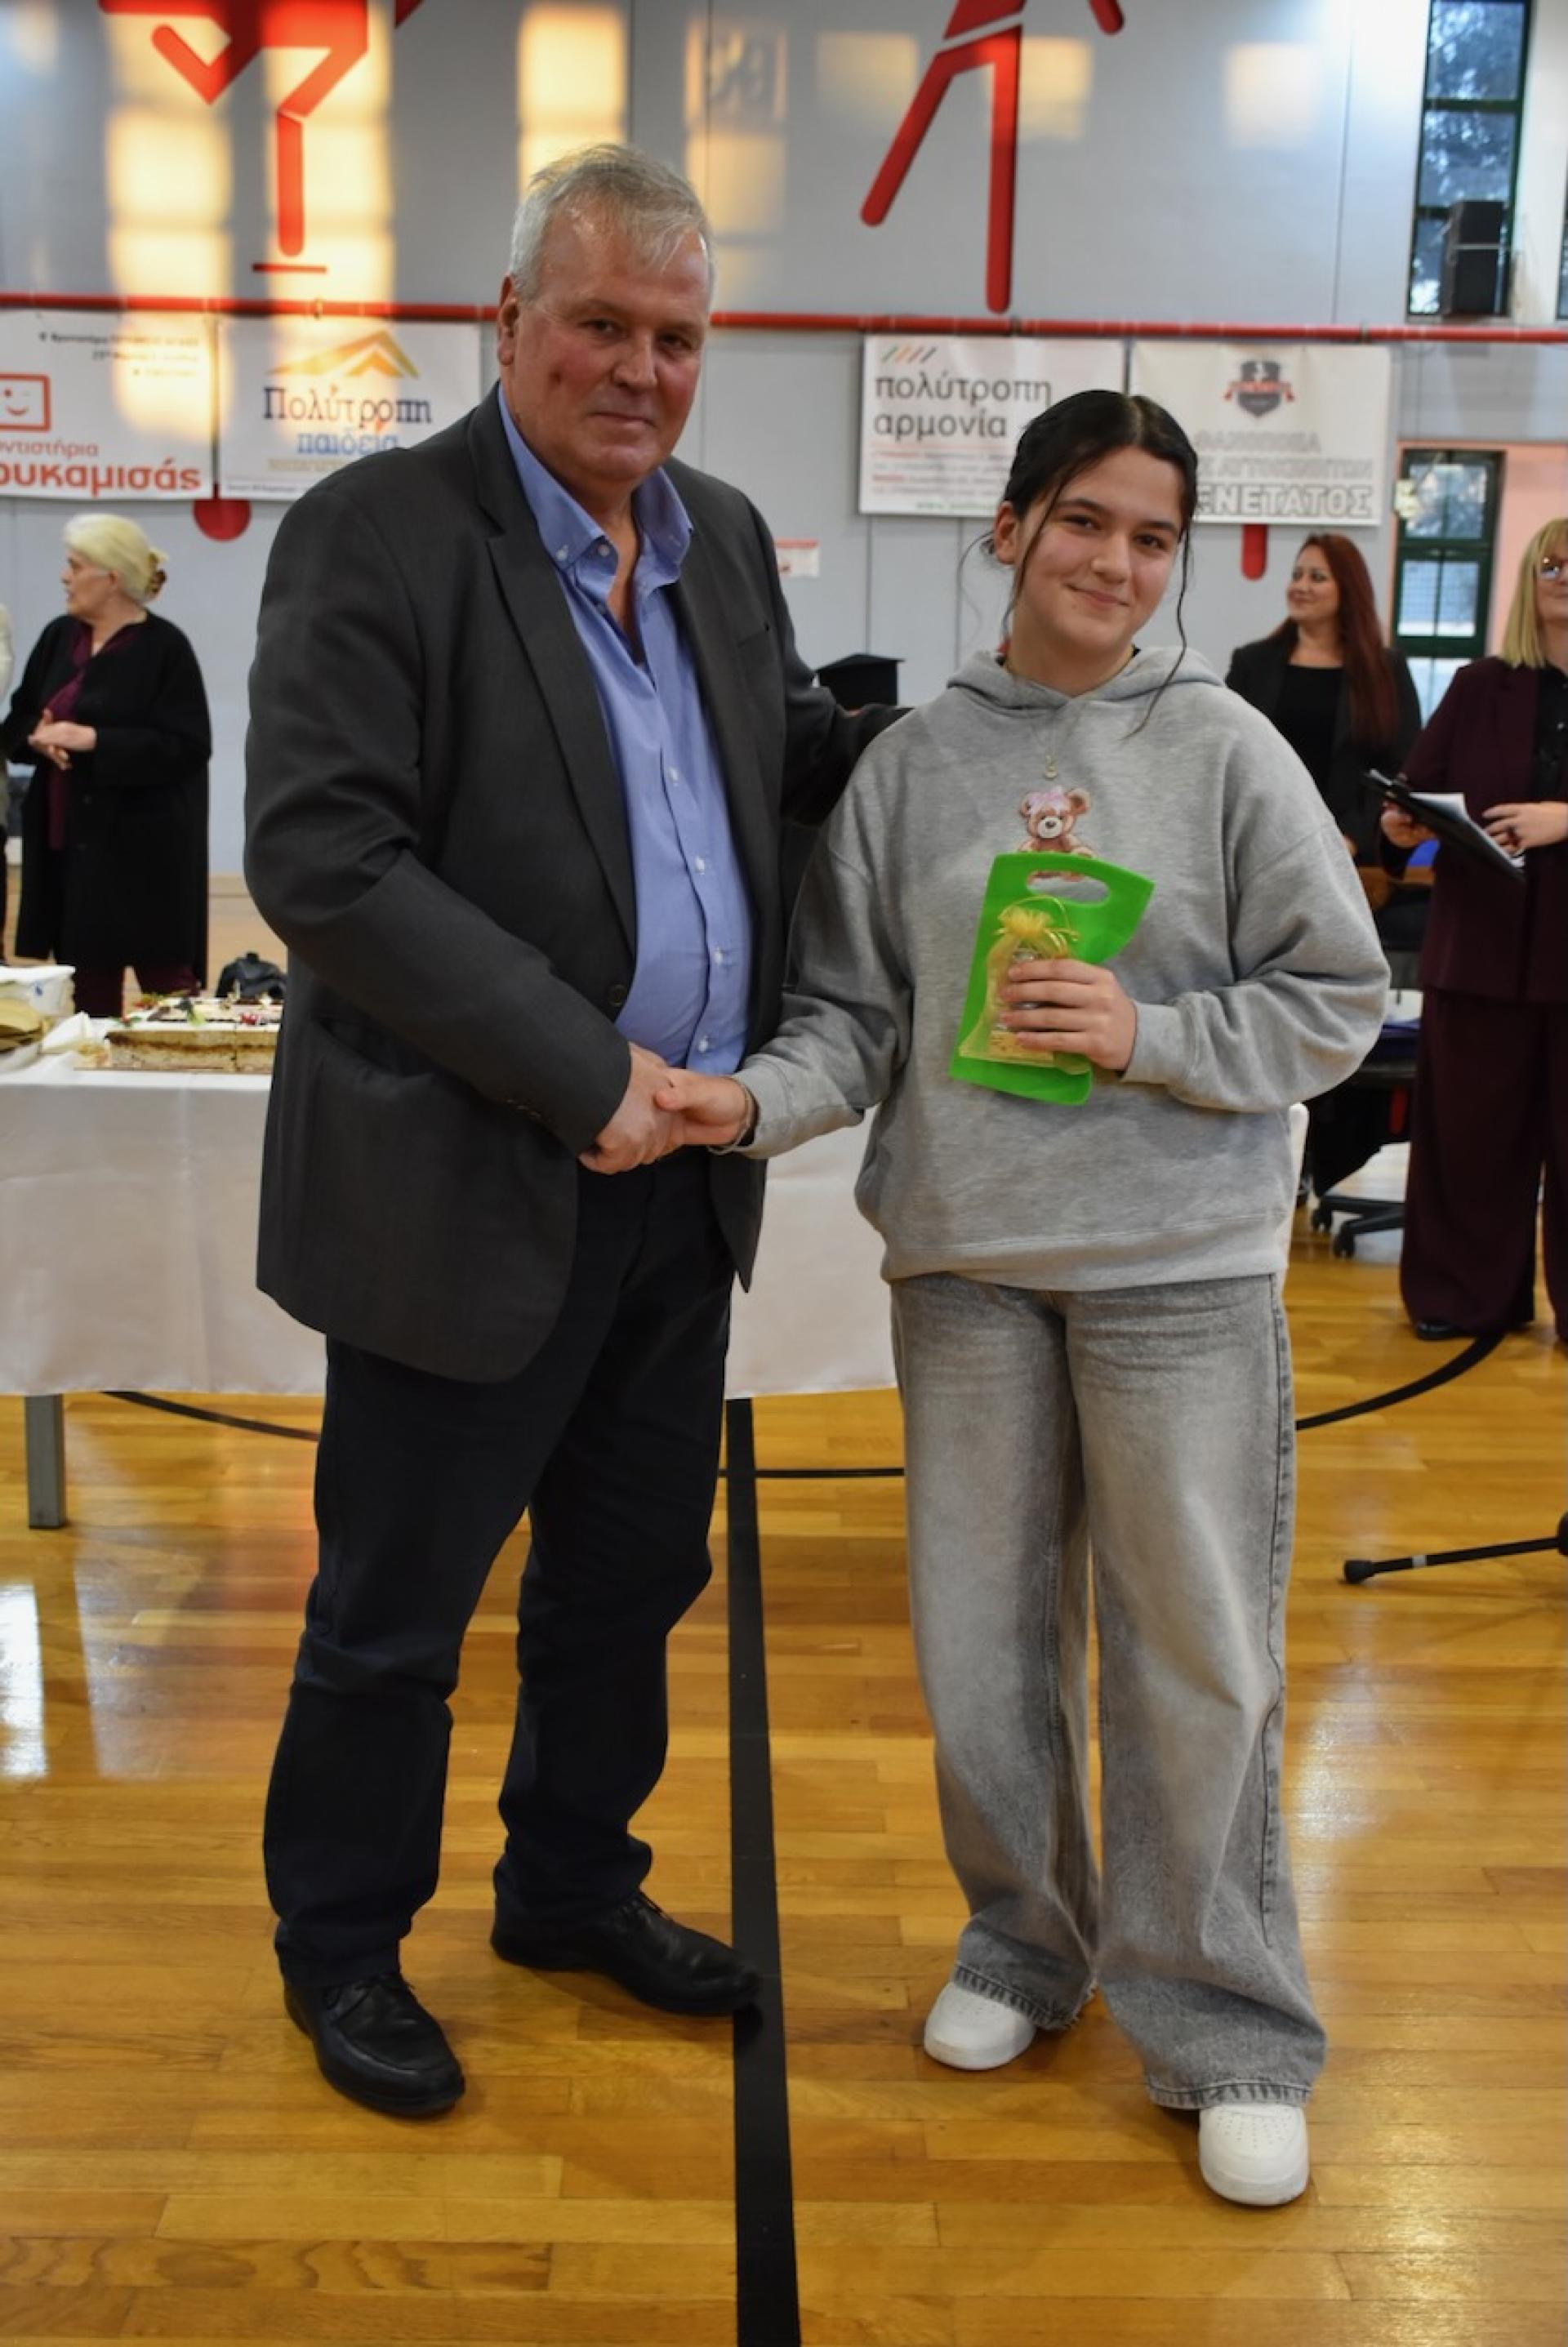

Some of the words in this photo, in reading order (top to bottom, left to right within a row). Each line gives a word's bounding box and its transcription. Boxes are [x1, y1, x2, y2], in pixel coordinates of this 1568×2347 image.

[263, 384, 432, 430] Πολύτροπη
[875, 370, 1052, 407] πολύτροπη
[875, 408, 1007, 442] αρμονία
